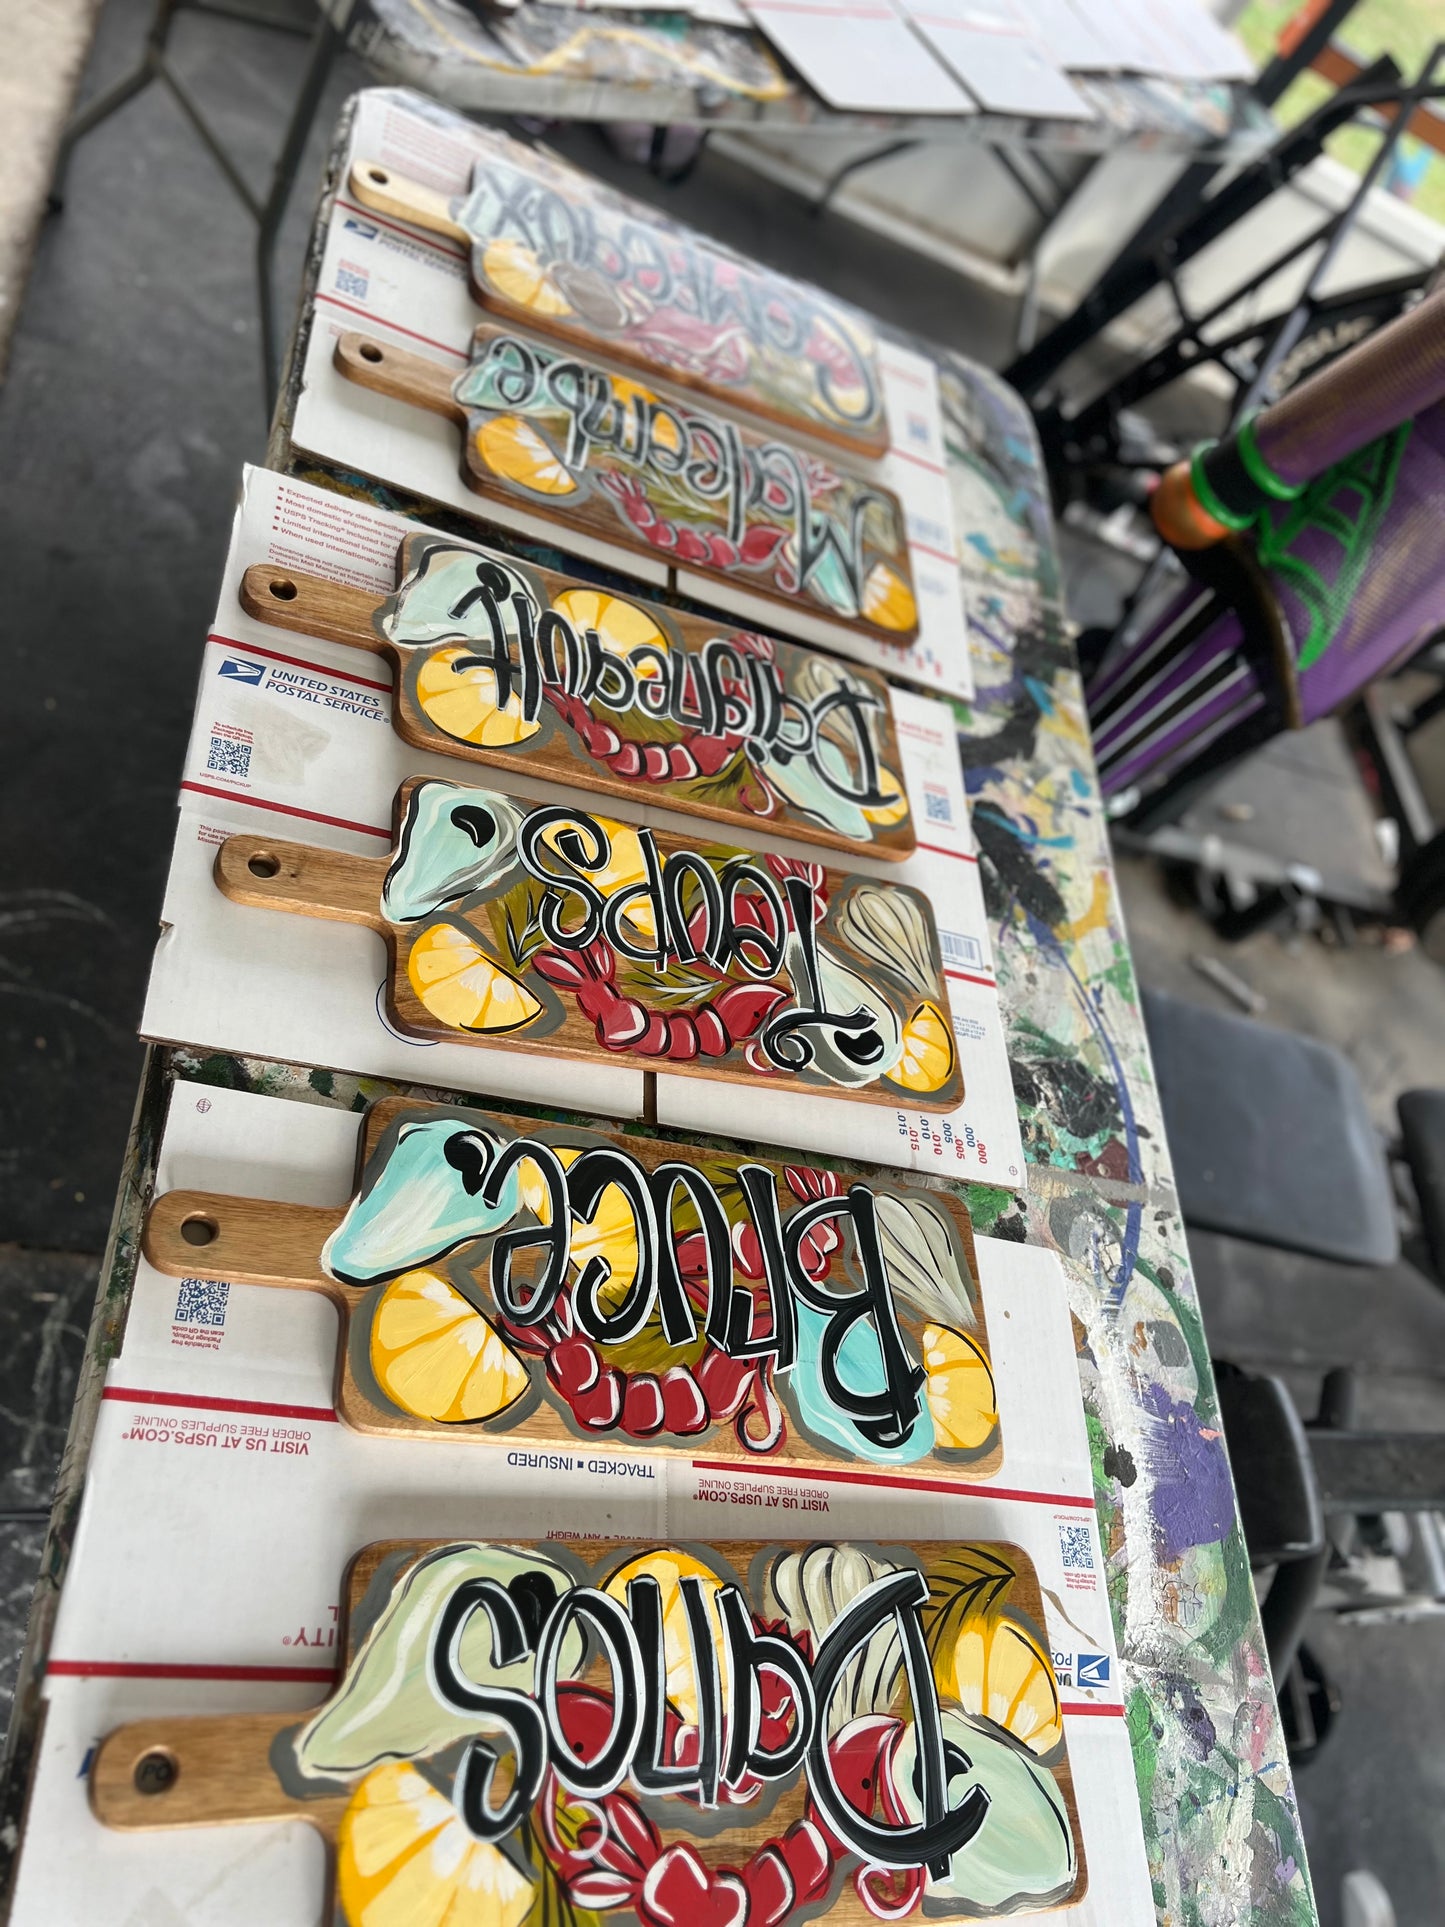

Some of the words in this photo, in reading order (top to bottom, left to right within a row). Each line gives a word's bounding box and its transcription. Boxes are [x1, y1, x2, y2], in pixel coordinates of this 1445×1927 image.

[284, 508, 306, 520] USPS
[265, 680, 321, 704] POSTAL
[271, 668, 328, 692] UNITED
[329, 686, 381, 707] STATES
[448, 586, 900, 810] Daigneault
[517, 805, 879, 1073] Toups
[897, 1112, 908, 1136] .015
[920, 1116, 930, 1140] .010
[942, 1120, 953, 1144] .005
[909, 1126, 920, 1150] .015
[932, 1131, 942, 1156] .010
[964, 1124, 976, 1148] .000
[954, 1136, 965, 1160] .005
[977, 1140, 988, 1164] .000
[483, 1138, 928, 1434] Bruce
[132, 1415, 178, 1428] ONLINE
[181, 1420, 238, 1434] SUPPLIES
[240, 1425, 270, 1436] FREE
[221, 1435, 242, 1448] AT
[272, 1428, 312, 1441] ORDER
[246, 1438, 268, 1452] US
[270, 1440, 310, 1456] VISIT
[507, 1452, 574, 1471] INSURED
[588, 1460, 655, 1478] TRACKED
[699, 1478, 732, 1490] ONLINE
[733, 1482, 775, 1494] SUPPLIES
[776, 1486, 798, 1496] FREE
[765, 1496, 780, 1508] AT
[800, 1488, 830, 1500] ORDER
[782, 1498, 798, 1509] US
[800, 1499, 830, 1512] VISIT
[426, 1570, 992, 1881] Danos
